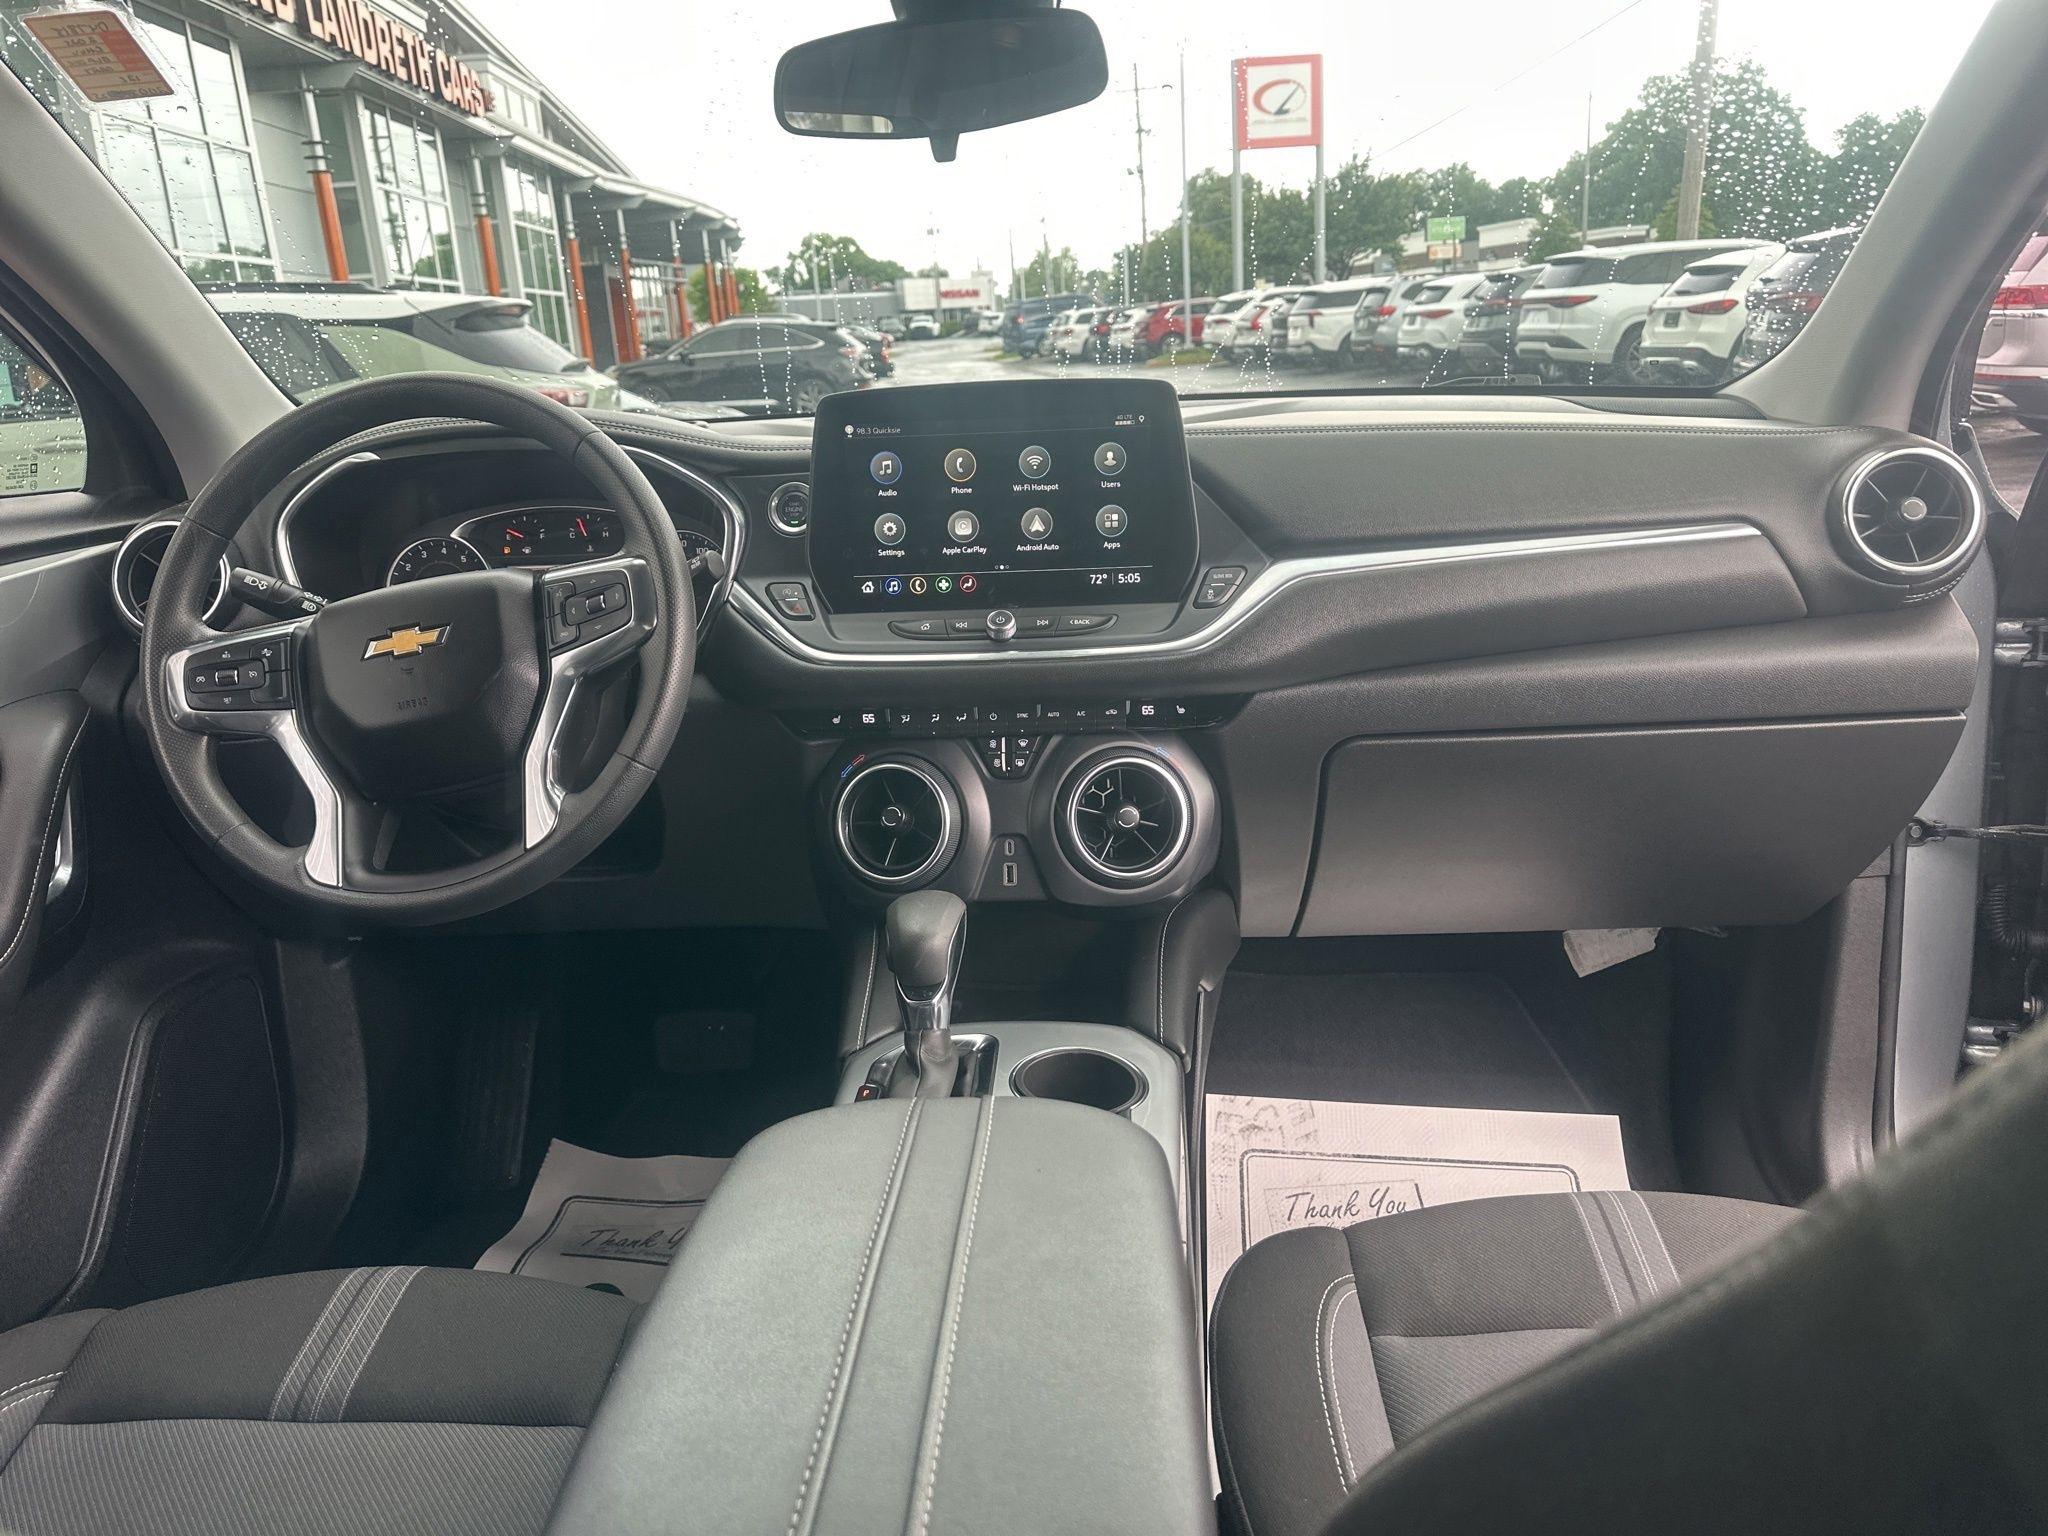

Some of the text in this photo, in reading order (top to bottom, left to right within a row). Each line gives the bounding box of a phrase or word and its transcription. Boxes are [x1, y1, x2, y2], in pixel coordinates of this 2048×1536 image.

[304, 0, 487, 118] LANDRETH CARS
[1013, 483, 1059, 493] Wi-Fi Hotspot
[1101, 480, 1121, 488] Users
[878, 489, 898, 497] Audio
[951, 486, 972, 494] Phone
[1016, 543, 1059, 551] Android Auto
[1103, 541, 1121, 549] Apps
[878, 548, 905, 557] Settings
[942, 546, 987, 555] Apple CarPlay
[405, 563, 411, 571] 2
[1118, 573, 1141, 583] 5:05
[1141, 706, 1154, 715] 65
[862, 714, 875, 723] 65
[863, 1089, 870, 1097] P
[1285, 1186, 1407, 1221] Thank You
[580, 1228, 665, 1248] Thank
